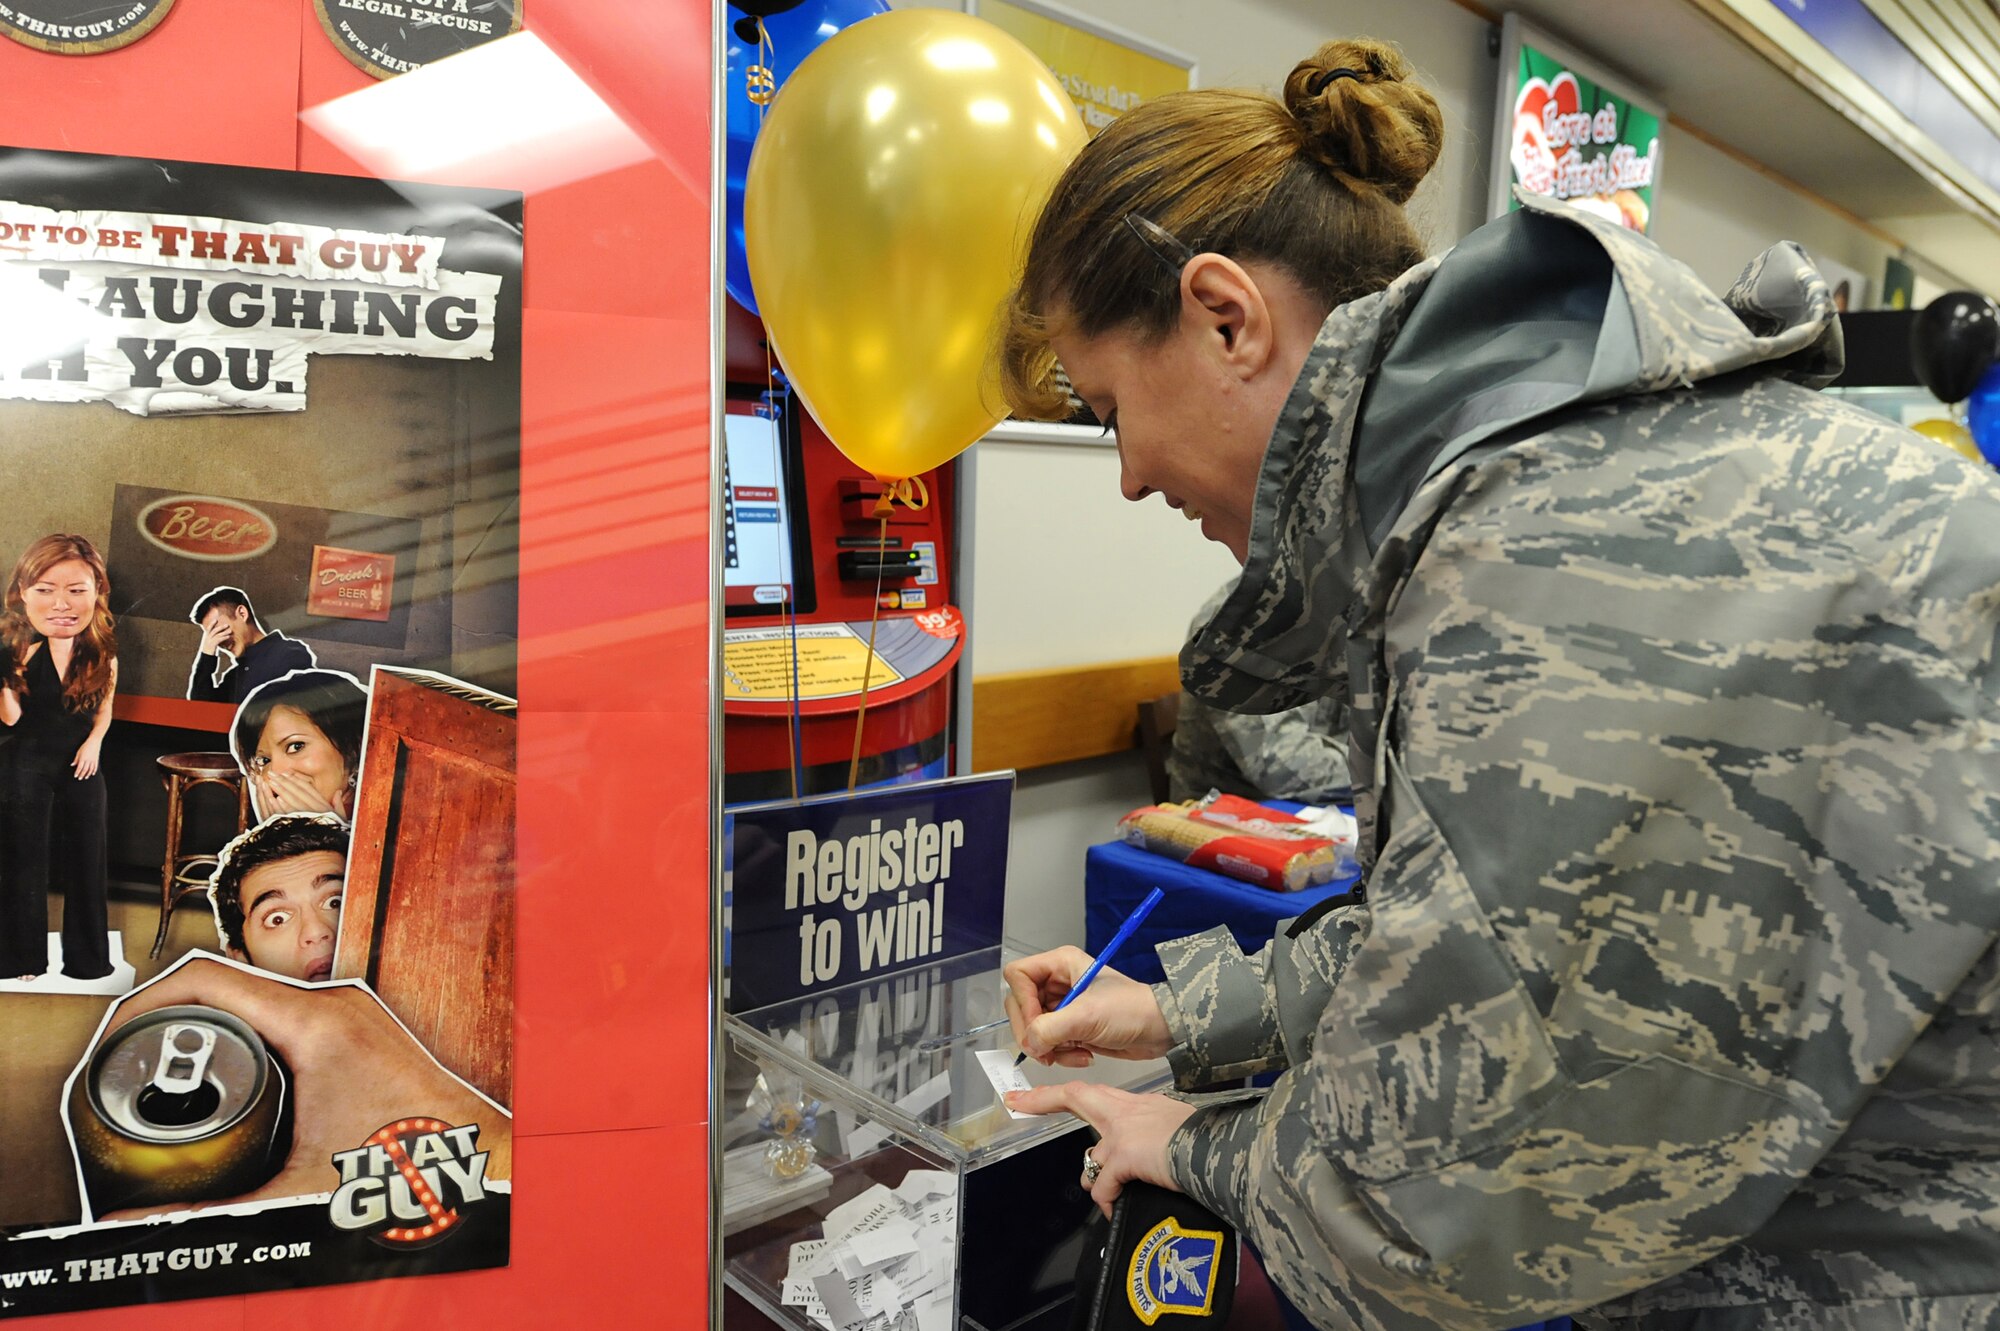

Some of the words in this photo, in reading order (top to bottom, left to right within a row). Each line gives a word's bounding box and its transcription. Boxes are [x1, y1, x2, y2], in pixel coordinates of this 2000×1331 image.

[339, 0, 406, 18] LEGAL
[410, 8, 492, 35] EXCUSE
[43, 225, 88, 245] TO
[97, 229, 142, 249] BE
[152, 225, 304, 265] THAT
[318, 238, 426, 273] GUY
[39, 268, 478, 340] AUGHING
[117, 337, 293, 393] YOU.
[160, 506, 263, 542] Beer
[319, 563, 374, 586] Drink
[338, 586, 368, 599] BEER
[785, 817, 964, 911] Register
[800, 913, 842, 987] to
[856, 882, 944, 972] win!
[333, 1124, 478, 1184] THAT
[330, 1152, 488, 1230] GUY
[1135, 1228, 1167, 1272] DEFENSOR
[1134, 1278, 1151, 1311] FORTIS
